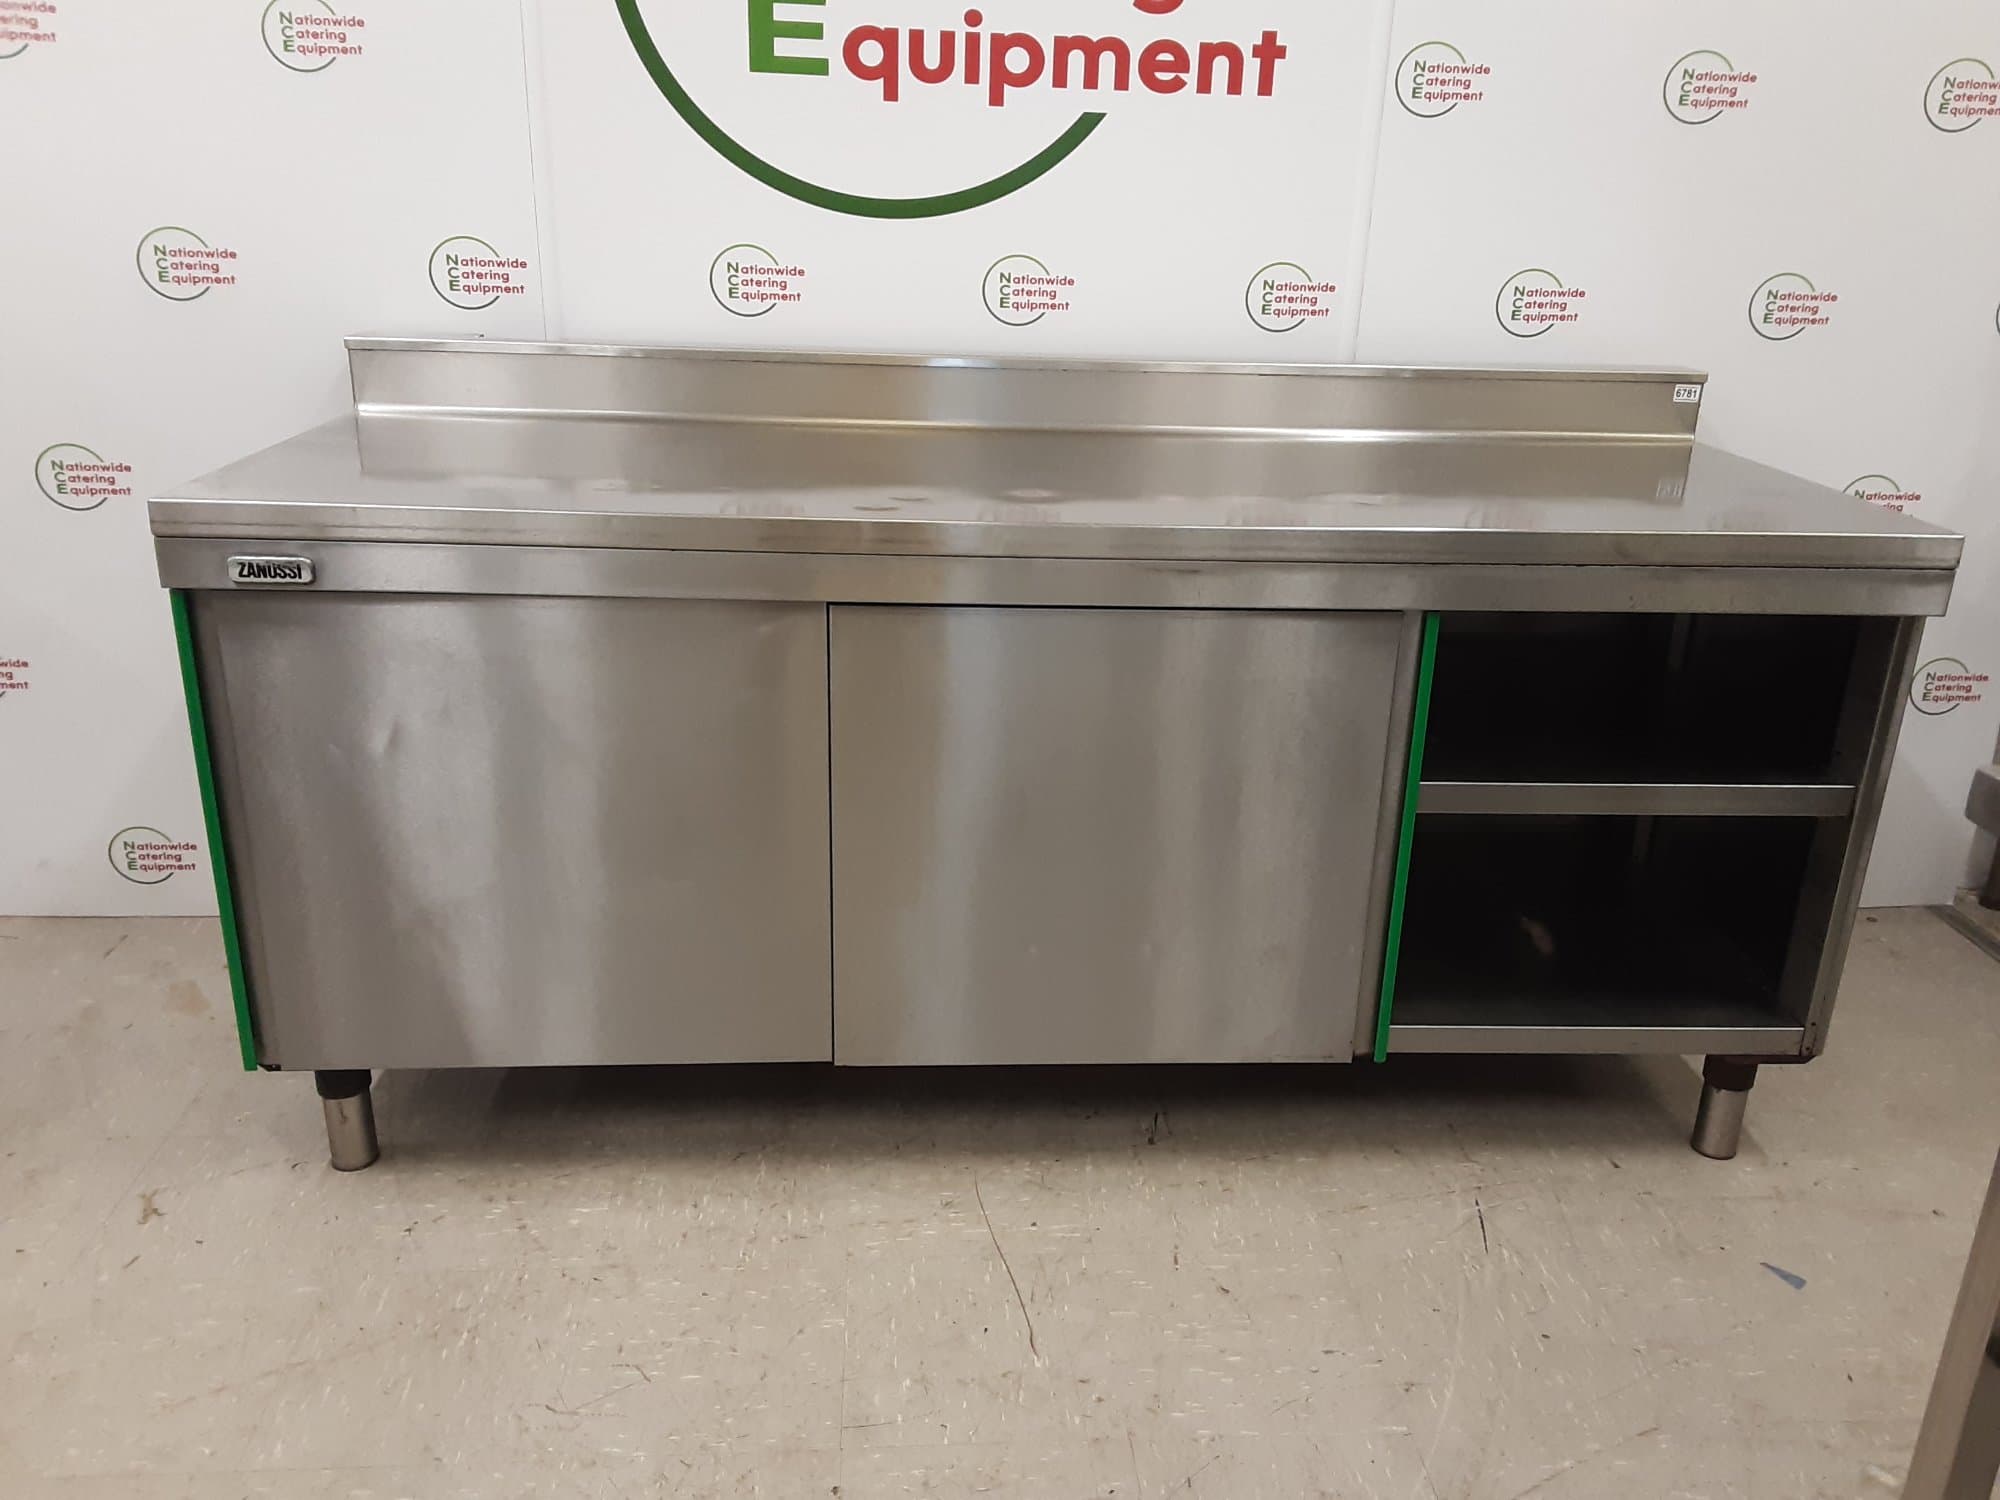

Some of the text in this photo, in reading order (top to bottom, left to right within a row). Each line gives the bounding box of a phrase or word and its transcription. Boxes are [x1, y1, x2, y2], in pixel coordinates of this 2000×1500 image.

[279, 12, 365, 28] Nationwide
[281, 26, 346, 43] Catering
[283, 40, 363, 56] Equipment
[749, 0, 1287, 106] Equipment
[1413, 60, 1491, 75] Nationwide
[1412, 74, 1471, 89] Catering
[1682, 69, 1757, 83] Nationwide
[1411, 86, 1483, 102] Equipment
[1680, 82, 1737, 96] Catering
[1678, 94, 1748, 109] Equipment
[1941, 89, 1997, 106] Catering
[154, 245, 237, 260] Nationwide
[156, 259, 220, 273] Catering
[446, 254, 527, 269] Nationwide
[448, 267, 509, 283] Catering
[727, 262, 805, 277] Nationwide
[158, 271, 236, 286] Equipment
[728, 275, 787, 290] Catering
[999, 272, 1074, 286] Nationwide
[449, 280, 525, 295] Equipment
[999, 285, 1056, 299] Catering
[1263, 280, 1336, 293] Nationwide
[1514, 286, 1586, 298] Nationwide
[728, 288, 801, 302] Equipment
[1262, 292, 1318, 306] Catering
[1767, 290, 1838, 302] Nationwide
[999, 297, 1069, 312] Equipment
[1261, 304, 1329, 318] Equipment
[1513, 298, 1567, 311] Catering
[1765, 302, 1819, 315] Catering
[1511, 310, 1578, 323] Equipment
[1763, 314, 1830, 327] Equipment
[1676, 388, 1698, 398] 6781
[51, 460, 132, 473] Nationwide
[54, 473, 115, 485] Catering
[56, 484, 131, 497] Equipment
[1854, 490, 1921, 500] Nationwide
[237, 562, 302, 580] ZANUSSI
[1926, 672, 1989, 682] Nationwide
[1924, 682, 1972, 693] Catering
[1922, 692, 1981, 703] Equipment
[123, 841, 197, 851] Nationwide
[126, 851, 182, 862] Catering
[127, 861, 196, 872] Equipment
